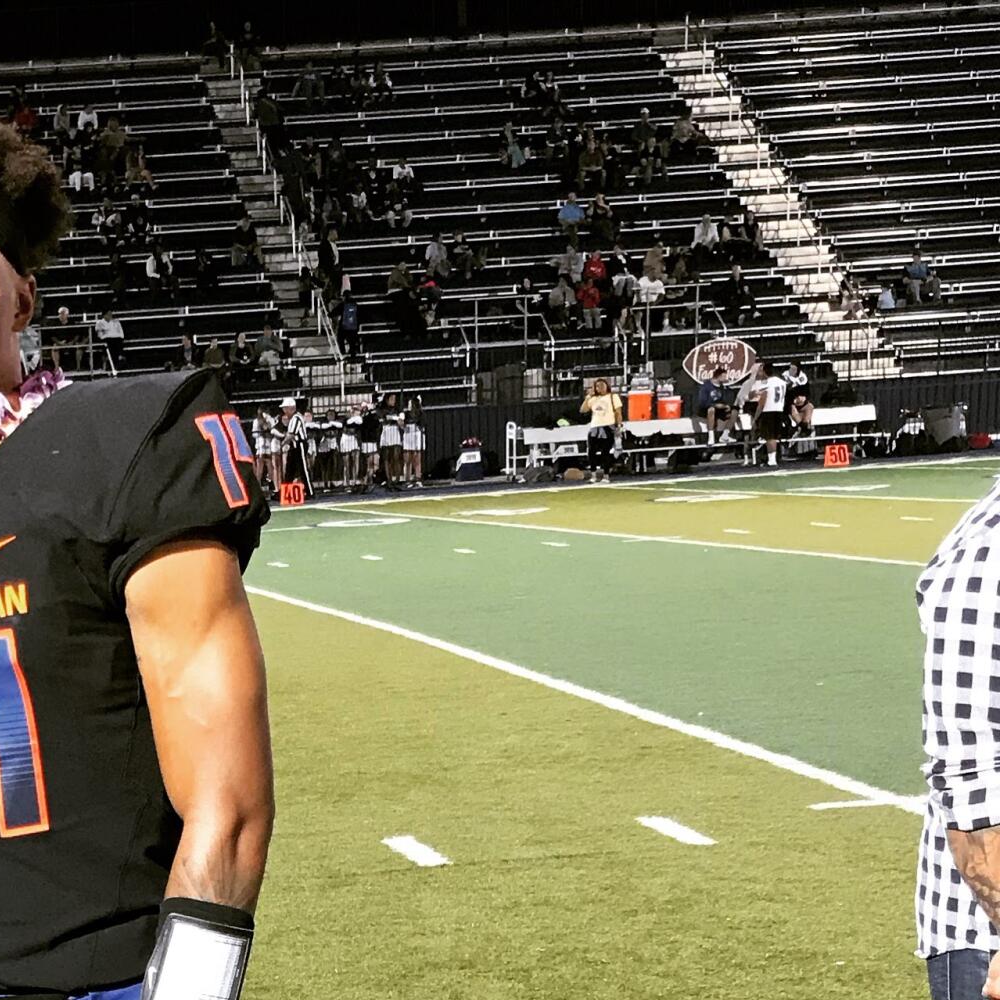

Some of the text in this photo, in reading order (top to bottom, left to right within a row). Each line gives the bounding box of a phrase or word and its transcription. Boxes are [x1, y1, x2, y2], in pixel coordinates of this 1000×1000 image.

[708, 351, 734, 363] #60
[829, 446, 847, 463] 50
[283, 484, 302, 504] 40
